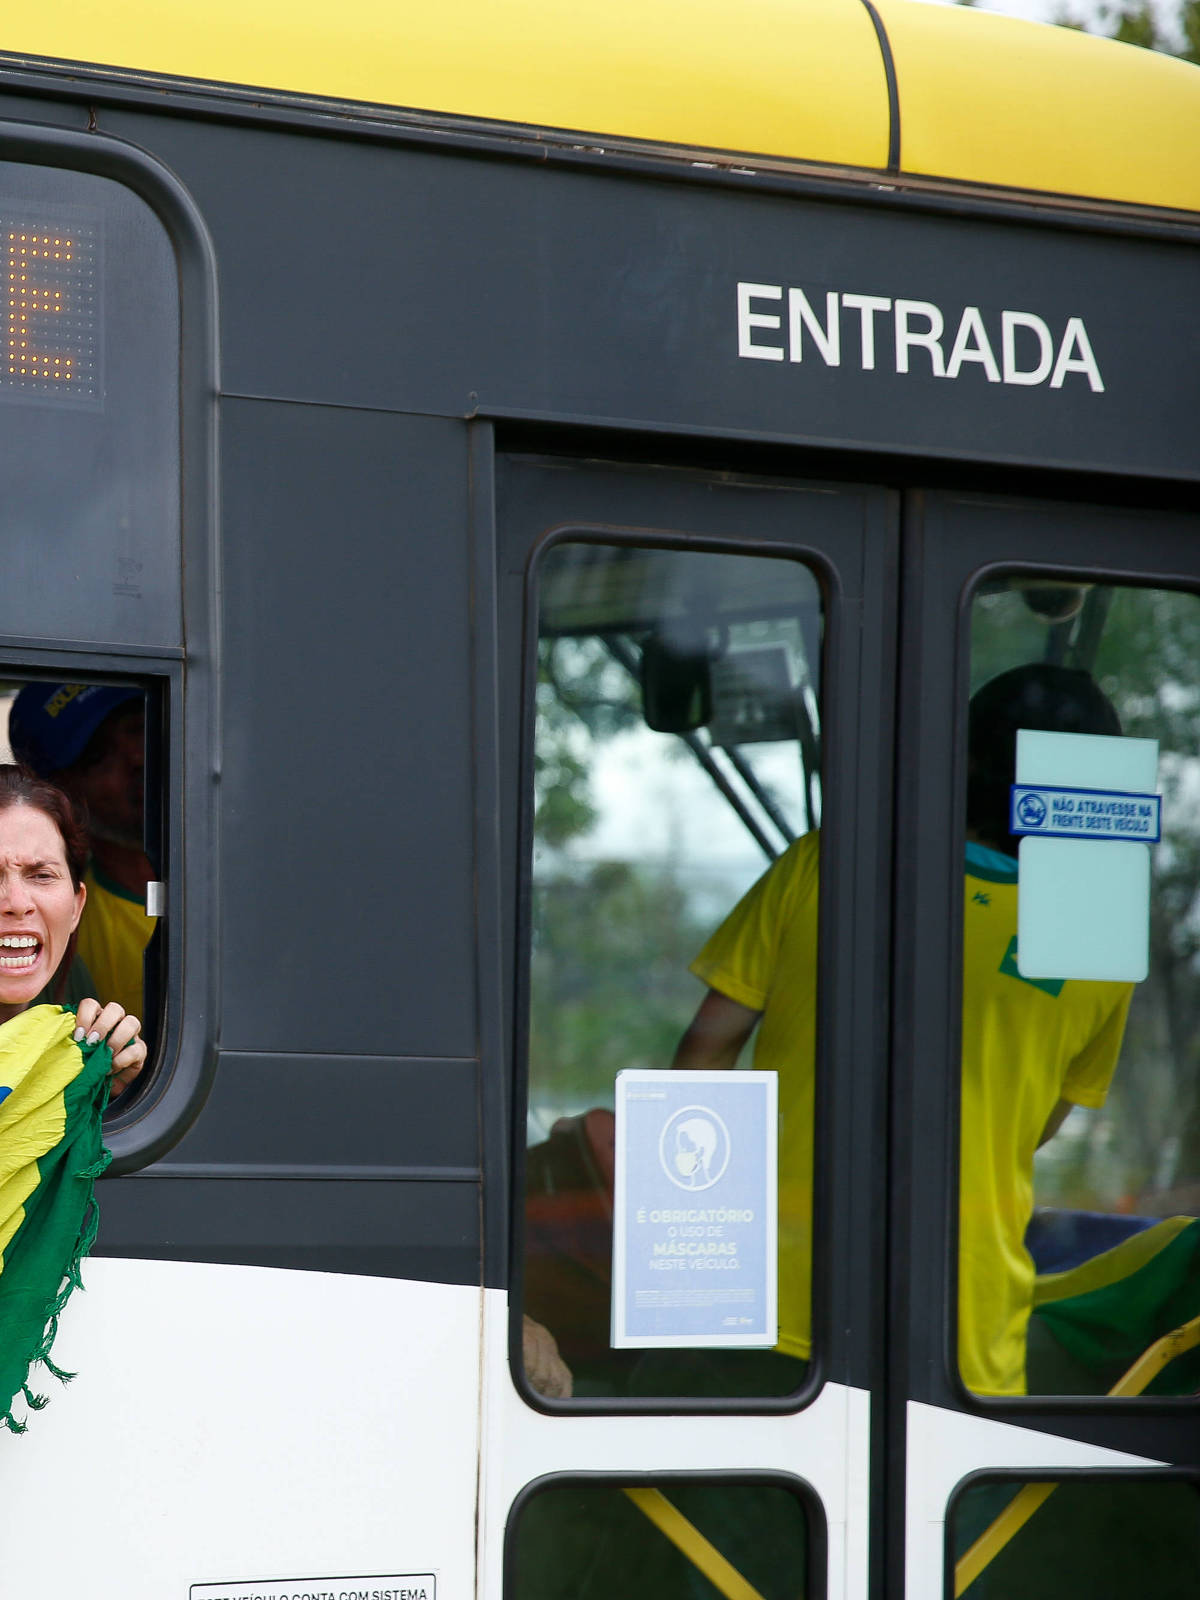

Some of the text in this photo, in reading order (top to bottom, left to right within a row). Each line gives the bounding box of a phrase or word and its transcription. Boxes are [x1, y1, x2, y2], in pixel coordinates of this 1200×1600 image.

[737, 282, 1105, 393] ENTRADA
[636, 1205, 755, 1224] É OBRIGATÓRIO
[667, 1225, 725, 1238] O USO DE
[653, 1239, 738, 1256] MÁSCARAS
[649, 1257, 688, 1271] NESTE
[372, 1589, 428, 1600] SISTEMA
